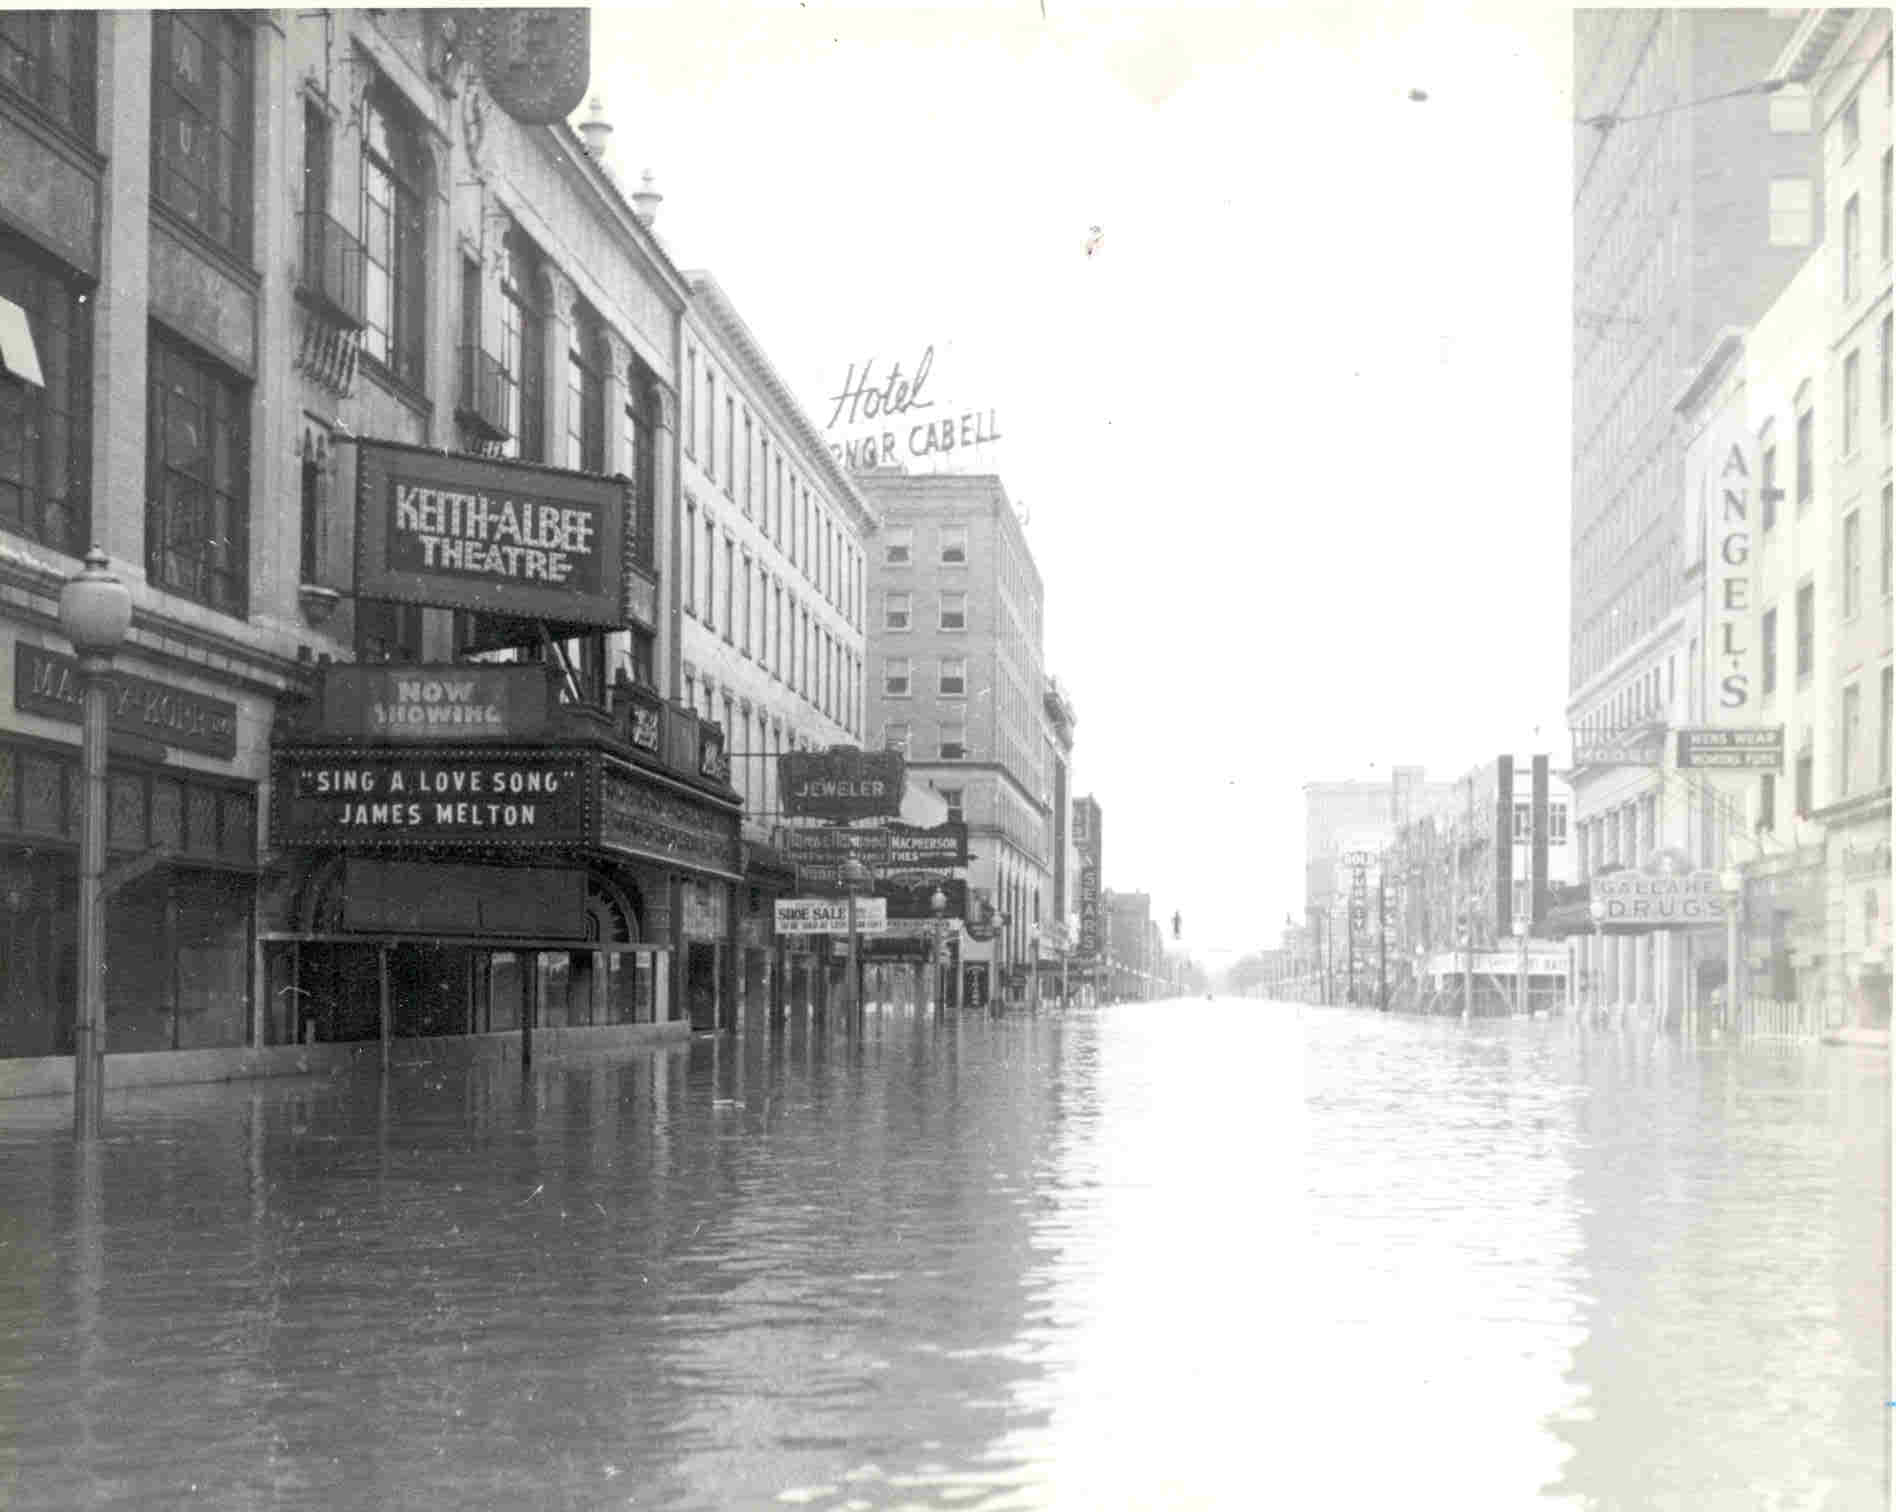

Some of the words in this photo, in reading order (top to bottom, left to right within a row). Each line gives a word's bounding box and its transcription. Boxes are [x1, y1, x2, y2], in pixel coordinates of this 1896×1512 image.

[827, 344, 935, 429] Hotel
[908, 408, 1002, 457] CABELL
[395, 484, 595, 554] KEITH-ALBEE
[419, 535, 573, 582] THEATRE
[397, 680, 475, 703] NOW
[373, 703, 502, 724] SHOWING
[301, 770, 374, 793] "SING
[391, 773, 405, 793] A
[420, 771, 482, 793] LOVE
[492, 770, 576, 794] SONG"
[793, 780, 885, 798] JEWELER
[339, 804, 422, 825] JAMES
[436, 804, 536, 826] MELTON
[813, 905, 846, 920] SALE
[1082, 871, 1096, 950] SEARS
[1607, 899, 1725, 918] DRUGS
